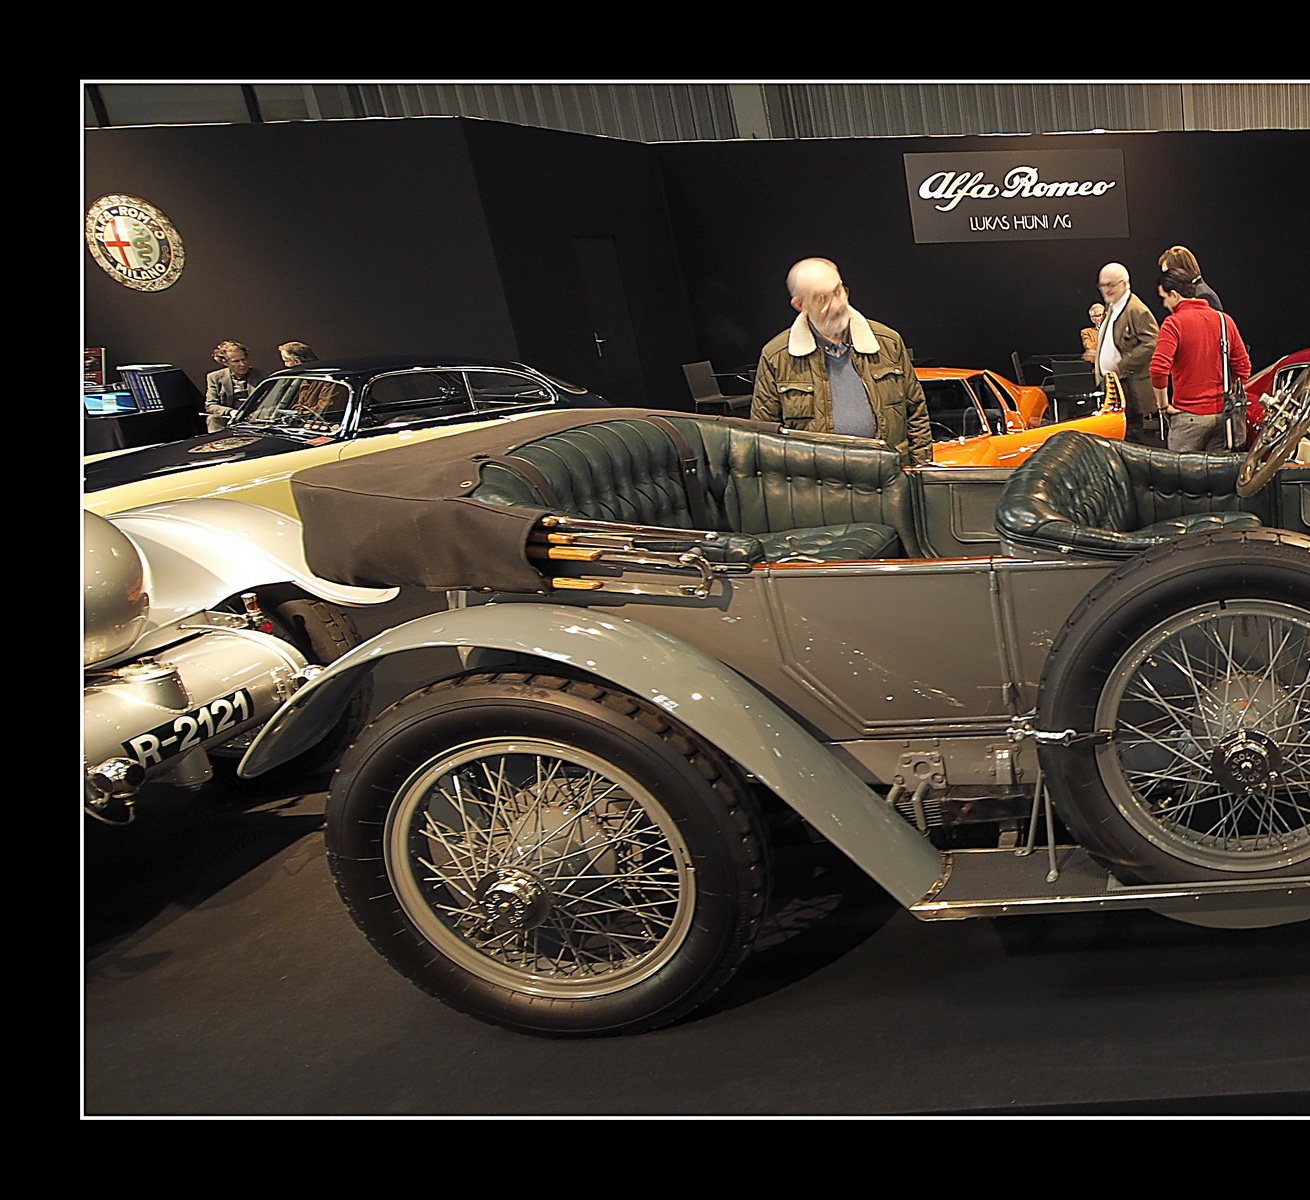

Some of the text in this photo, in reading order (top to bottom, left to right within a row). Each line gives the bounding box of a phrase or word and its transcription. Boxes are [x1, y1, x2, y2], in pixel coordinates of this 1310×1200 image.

[918, 165, 1116, 212] Alfa Romeo
[969, 213, 1072, 231] LUKAS HÜNI AG
[115, 262, 167, 281] MILANO
[129, 690, 249, 769] R-2121
